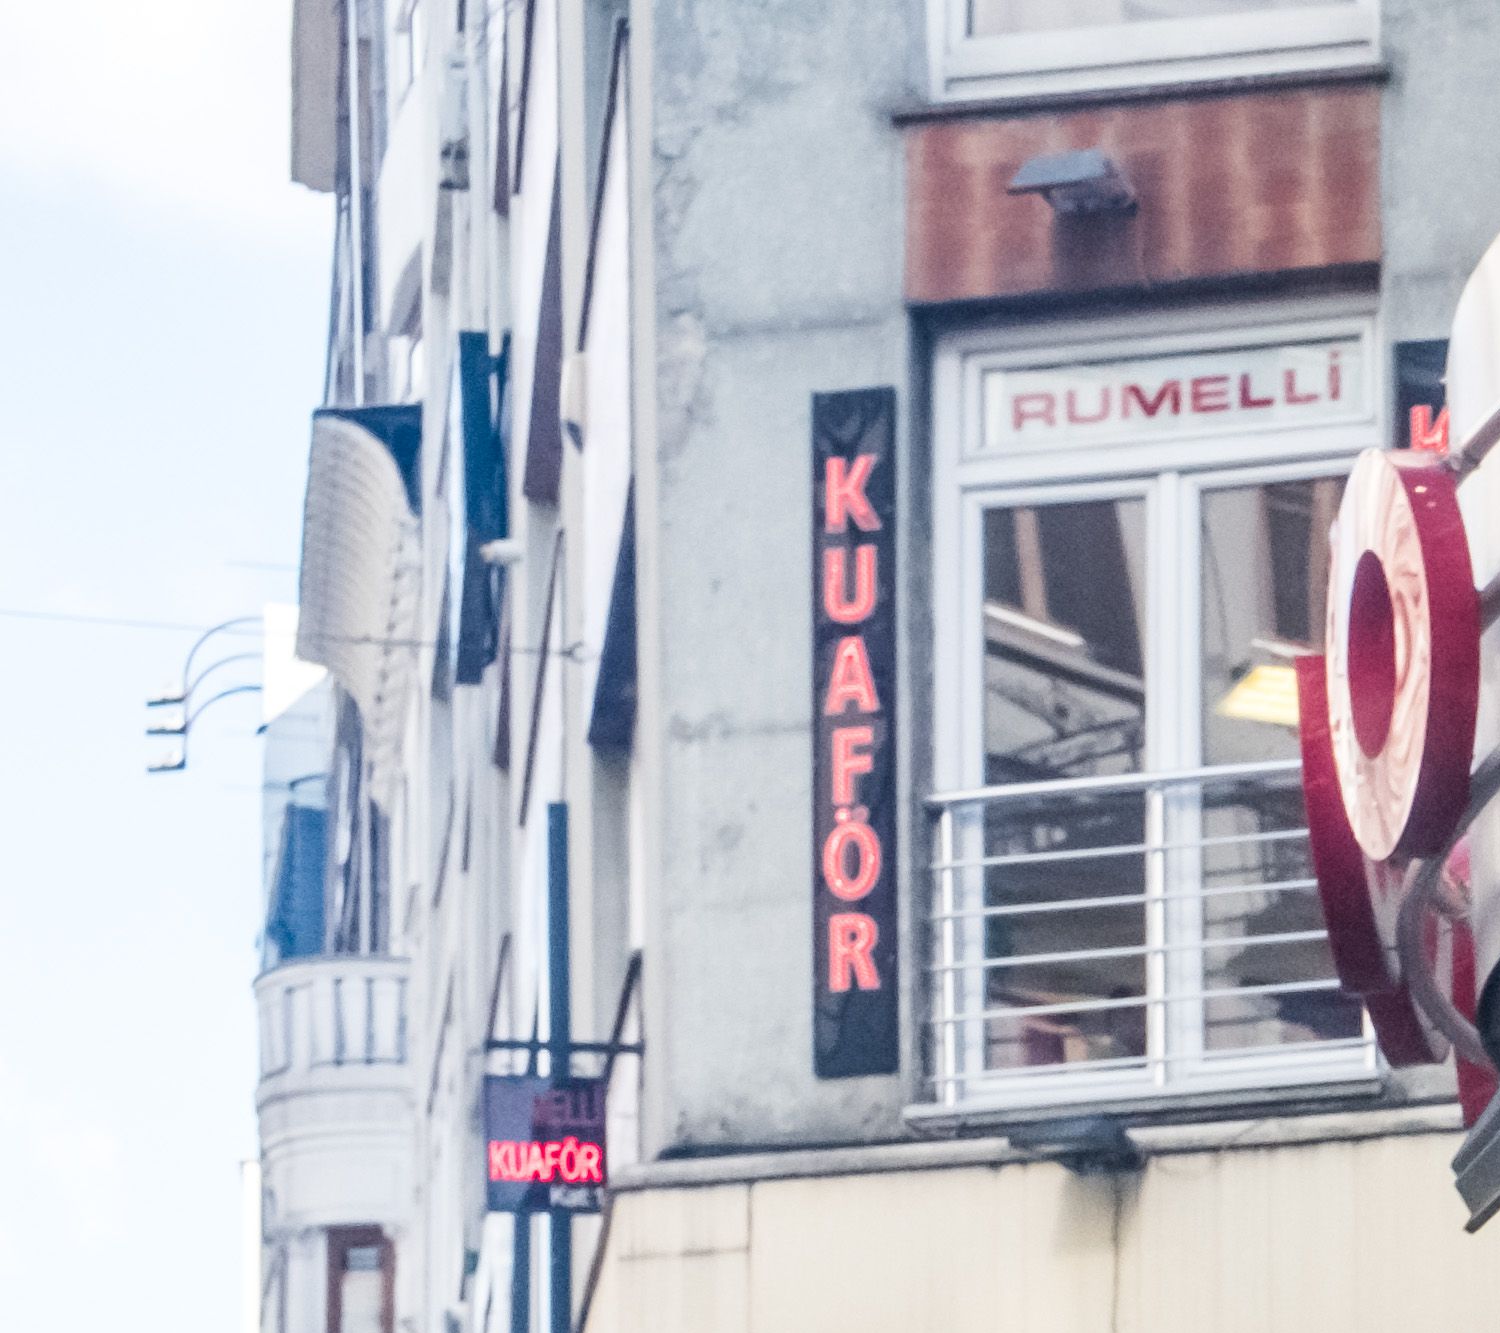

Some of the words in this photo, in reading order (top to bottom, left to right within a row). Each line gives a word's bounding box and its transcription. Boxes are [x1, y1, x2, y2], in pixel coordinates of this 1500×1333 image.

[1010, 350, 1344, 430] RUMELLİ
[823, 455, 881, 993] KUAFÖR
[489, 1136, 602, 1182] KUAFÖR
